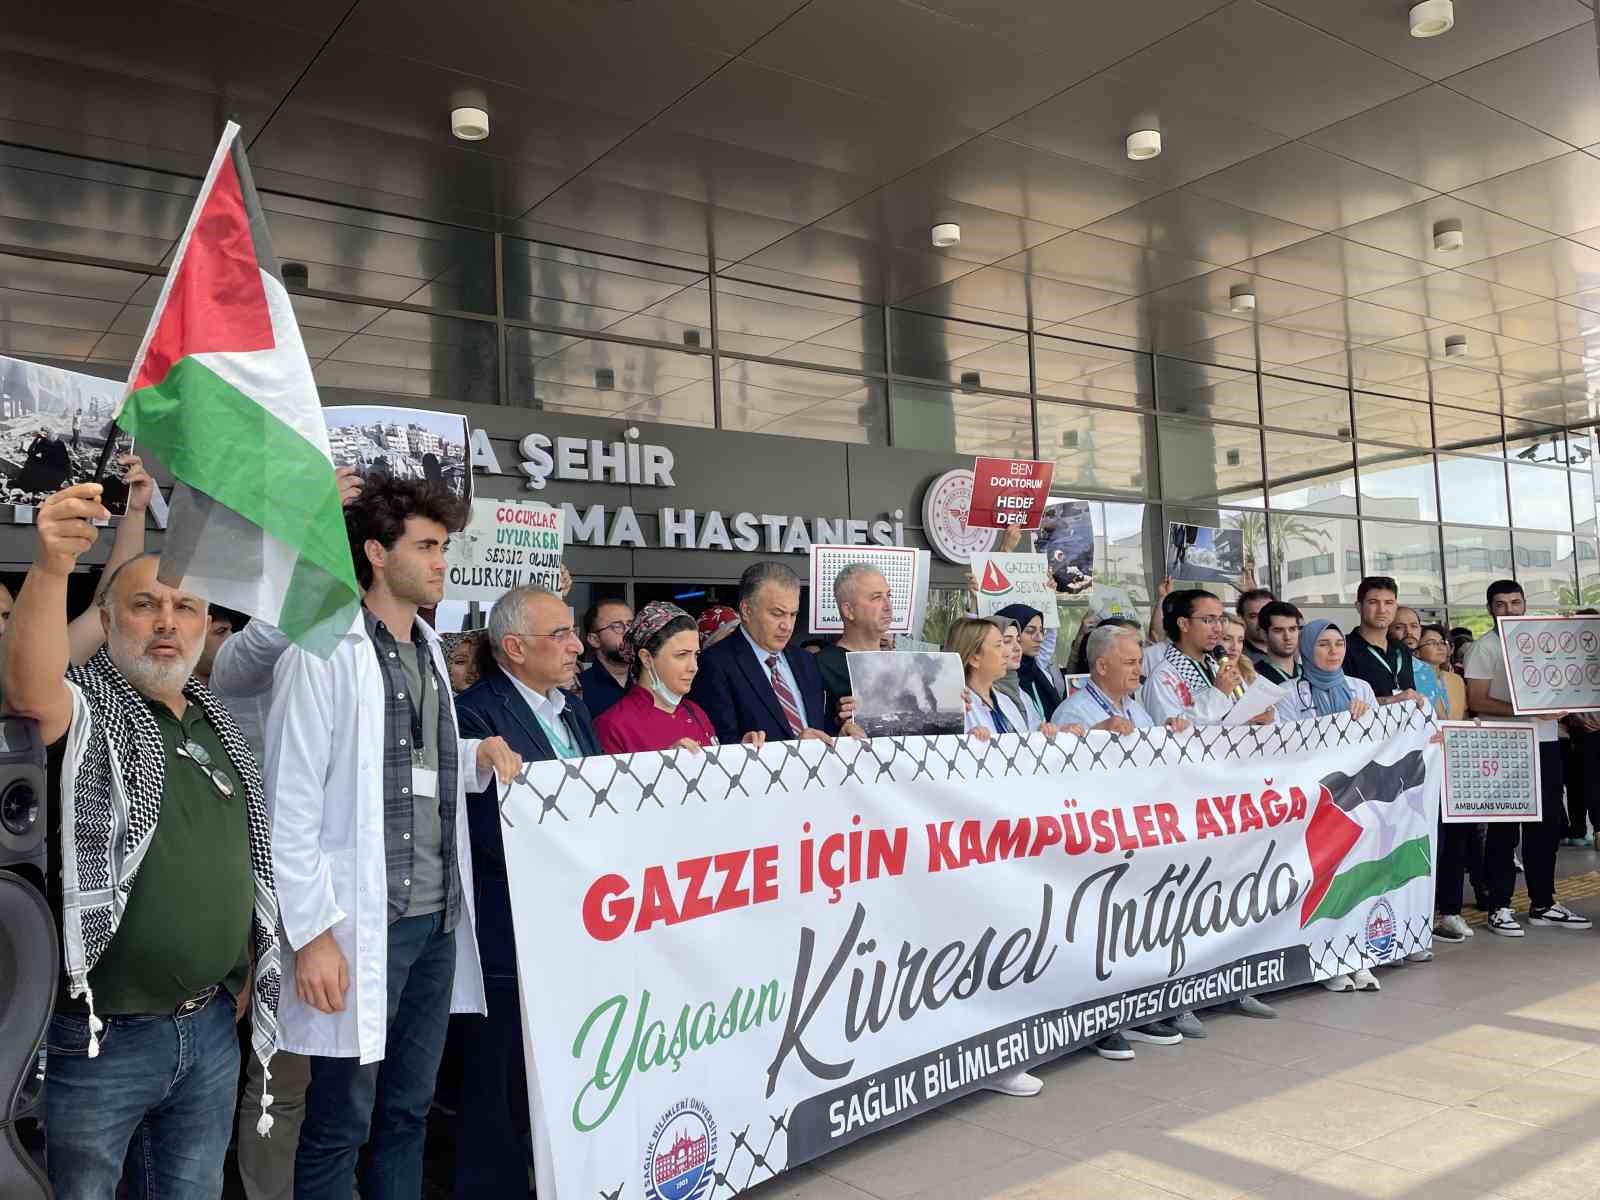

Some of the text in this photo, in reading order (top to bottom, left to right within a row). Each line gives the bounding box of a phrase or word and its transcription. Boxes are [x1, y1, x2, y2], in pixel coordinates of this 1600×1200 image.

[518, 426, 676, 490] ŞEHİR
[1010, 462, 1033, 476] BEN
[990, 476, 1043, 489] DOKTORUM
[996, 495, 1035, 509] HEDEF
[496, 527, 560, 550] UYURKEN
[658, 508, 905, 553] HASTANESİ
[1481, 760, 1499, 777] 59
[1454, 802, 1494, 811] AMBULANS
[582, 777, 1307, 942] GAZZE İÇİN KAMPÜSLER AYAĞA
[571, 839, 1312, 1133] Yaşasın Küresel İntifada
[829, 951, 1286, 1139] SAĞLIK BİLİMLERİ ÜNİVERSİTESİ ÖĞRENCİLERİ
